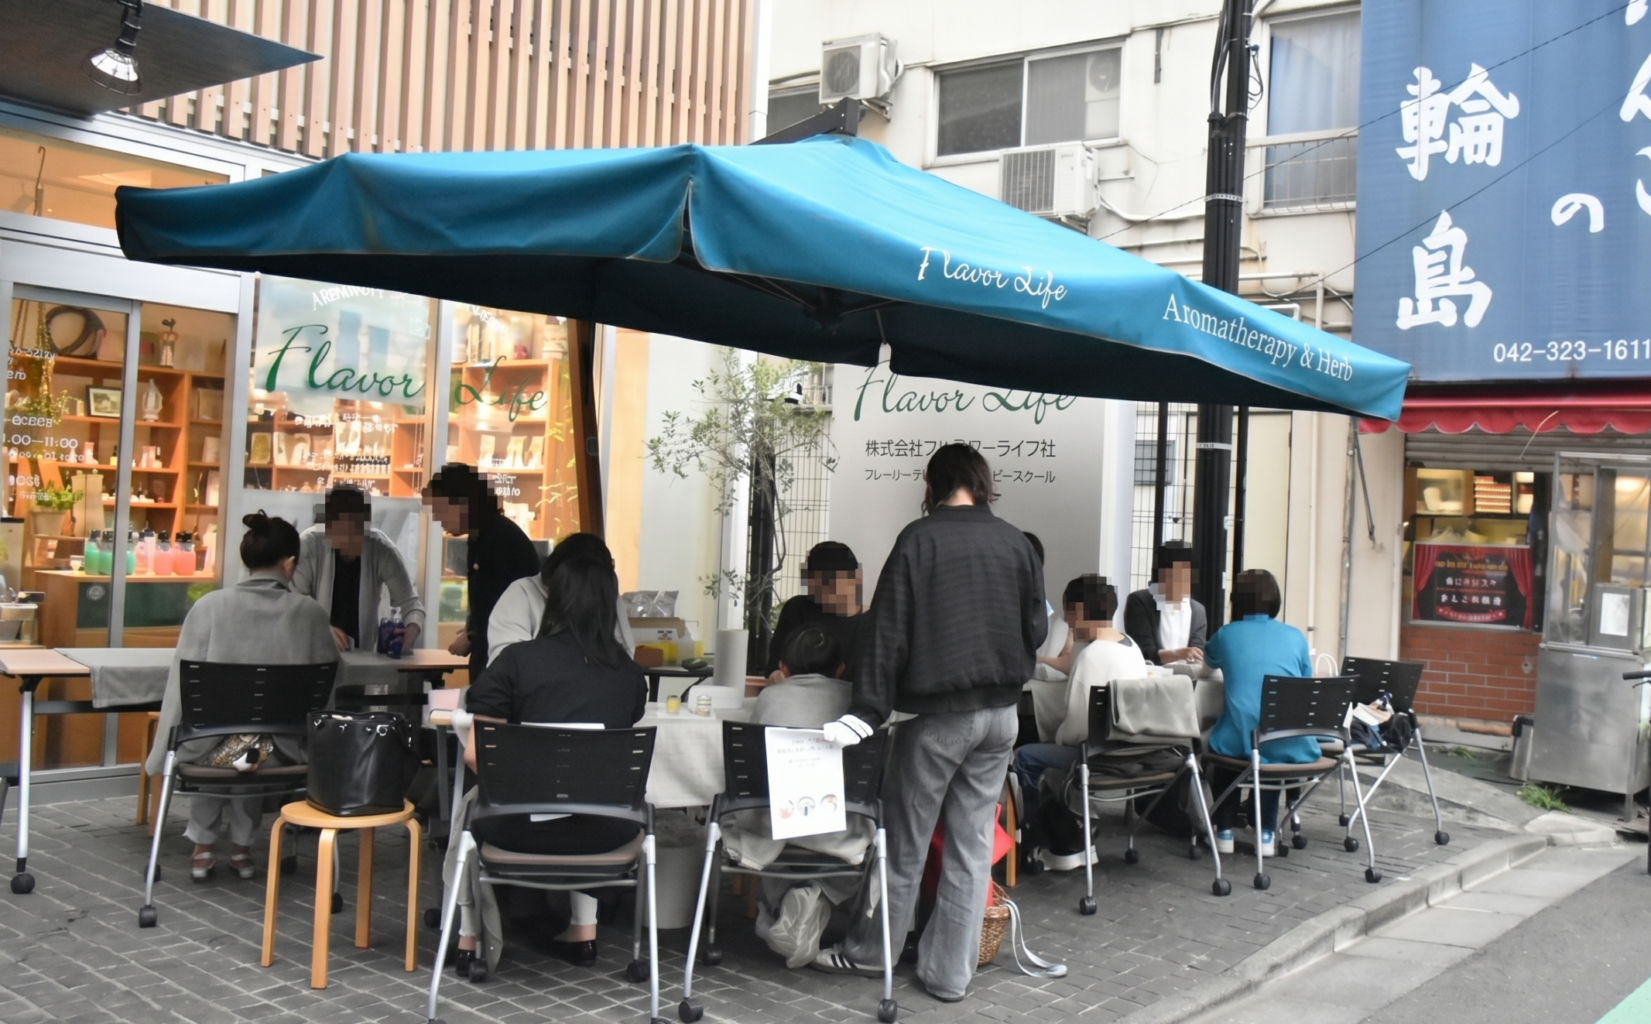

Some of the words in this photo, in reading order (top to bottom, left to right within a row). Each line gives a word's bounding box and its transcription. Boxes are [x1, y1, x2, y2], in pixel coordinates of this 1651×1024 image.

[918, 246, 1010, 289] Flavor
[1014, 266, 1068, 309] Life
[1162, 293, 1298, 367] Aromatherapy
[1300, 343, 1314, 367] &
[1315, 345, 1353, 382] Herb
[1493, 338, 1651, 363] 042-323-1611
[266, 324, 426, 398] Flavor
[453, 355, 548, 422] Life
[853, 359, 976, 422] Flavor
